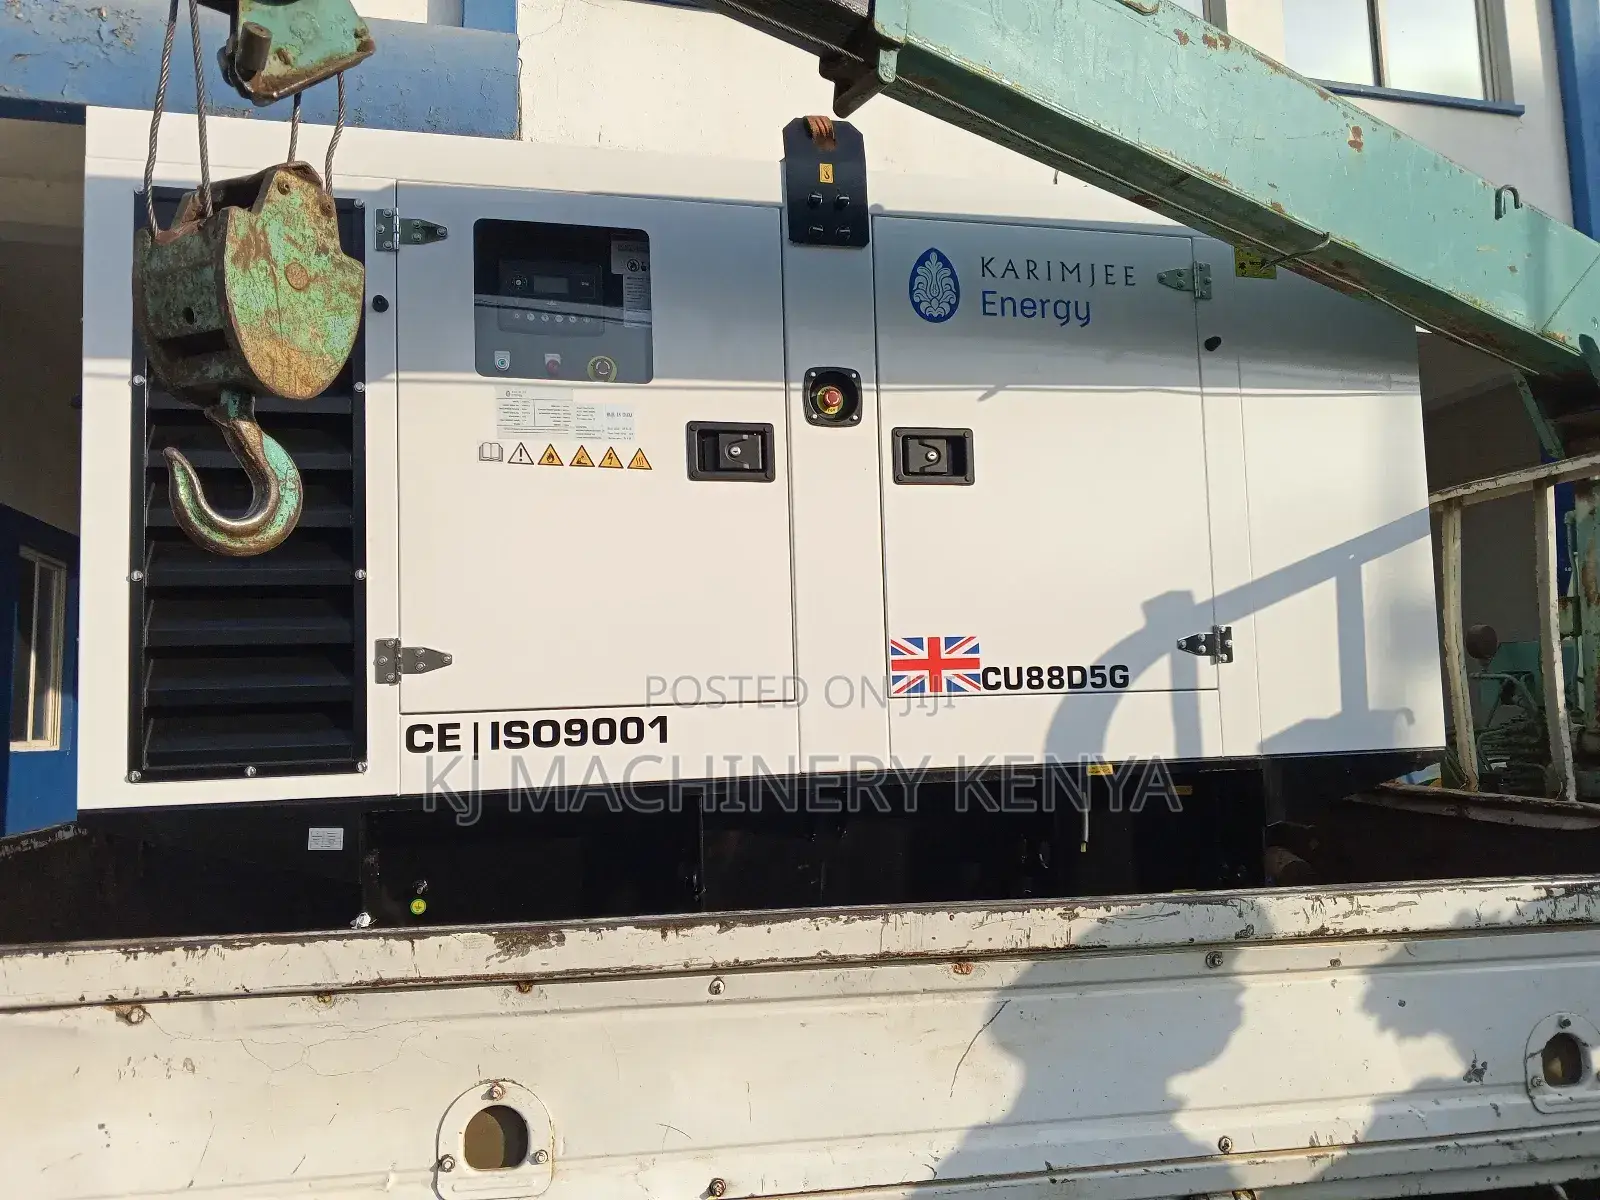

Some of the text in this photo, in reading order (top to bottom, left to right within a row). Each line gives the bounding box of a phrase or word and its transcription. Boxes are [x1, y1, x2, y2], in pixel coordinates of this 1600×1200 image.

[980, 256, 1137, 288] KARIMJEE
[981, 290, 1092, 328] Energy
[981, 664, 1130, 691] CU88D5G
[405, 722, 461, 753] CE
[490, 715, 668, 750] ISO9001
